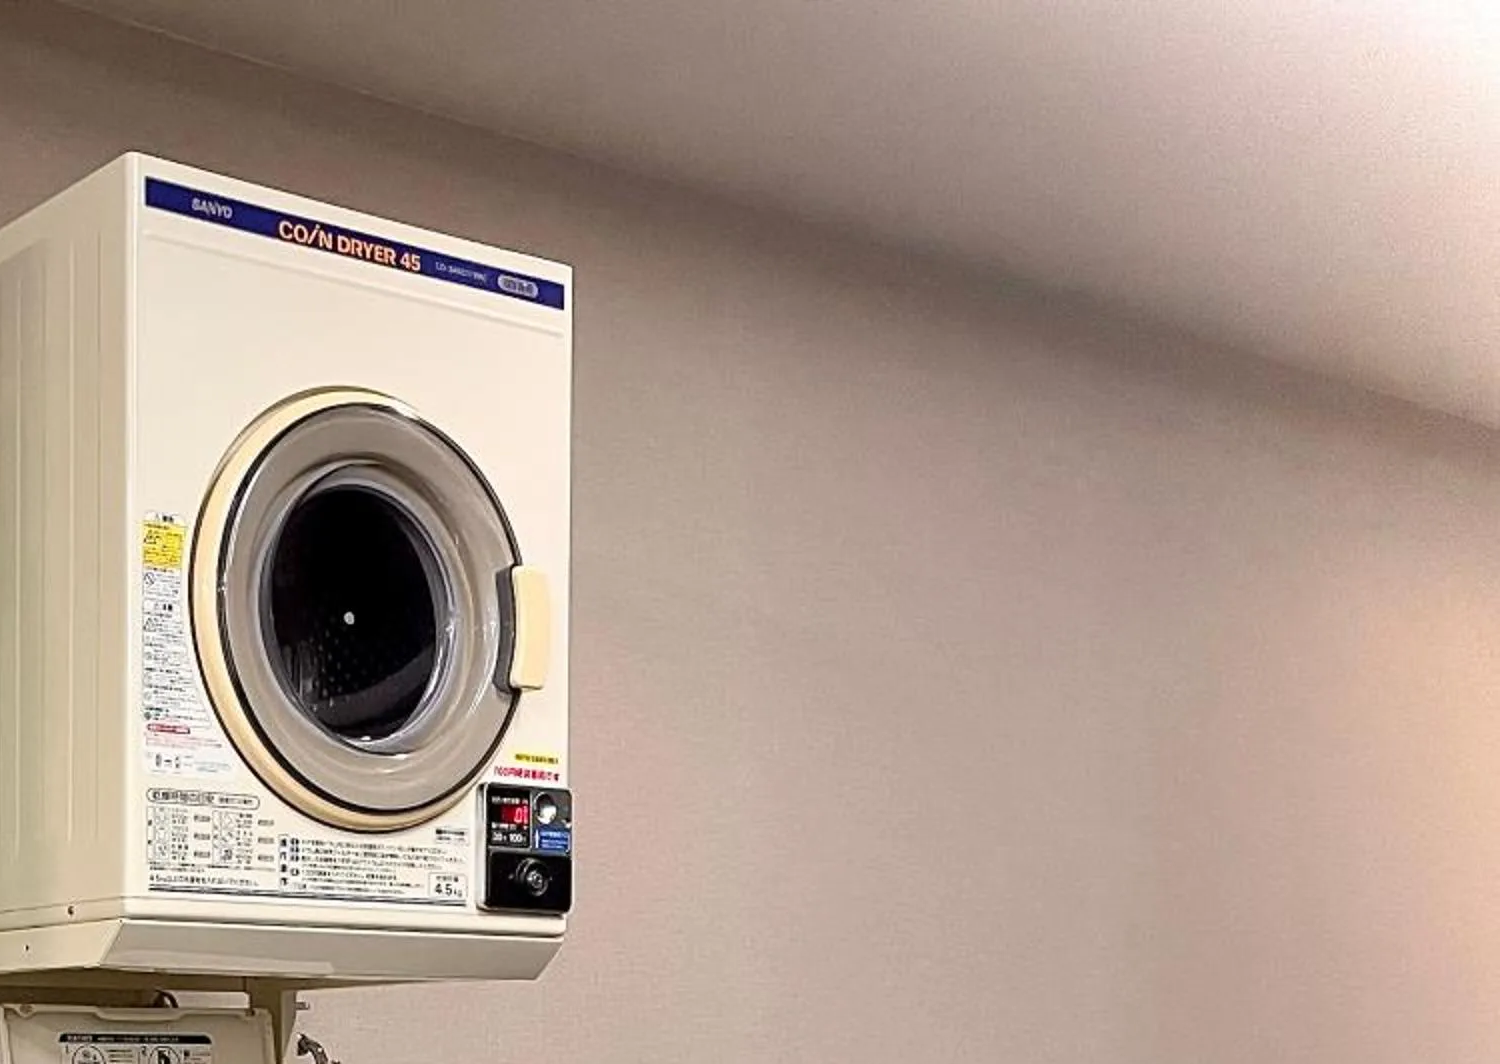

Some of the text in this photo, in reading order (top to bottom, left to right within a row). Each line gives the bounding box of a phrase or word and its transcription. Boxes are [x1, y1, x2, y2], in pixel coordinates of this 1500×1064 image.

[191, 197, 233, 219] SANYO
[337, 235, 397, 265] DRYER
[400, 252, 421, 272] 45
